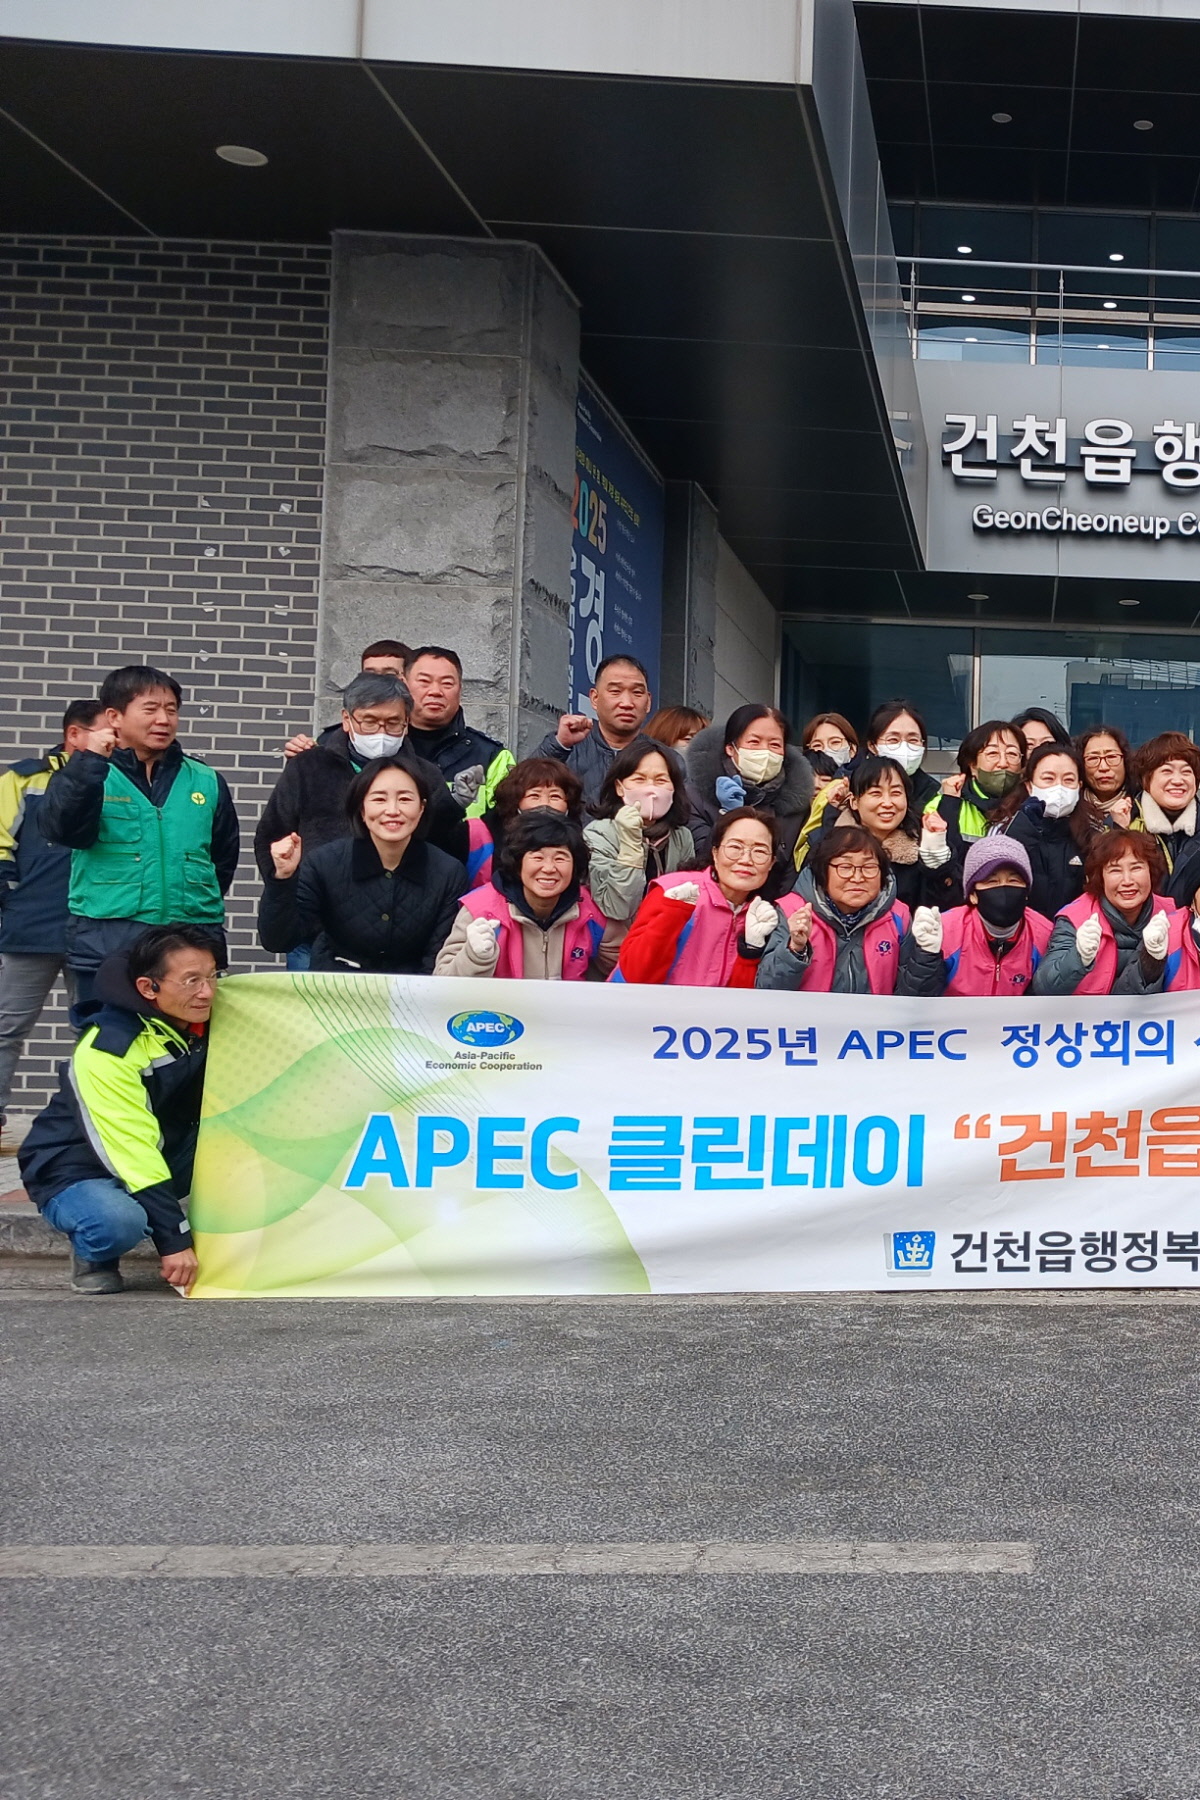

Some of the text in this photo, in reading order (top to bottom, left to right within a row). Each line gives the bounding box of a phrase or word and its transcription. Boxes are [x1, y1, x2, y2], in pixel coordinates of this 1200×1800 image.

[973, 504, 1170, 540] GeonCheoneup
[466, 1022, 505, 1033] APEC
[454, 1050, 516, 1061] Asia-Pacific
[652, 1025, 818, 1067] 2025년
[838, 1028, 967, 1061] APEC
[1001, 1020, 1175, 1068] 정상회의
[425, 1061, 543, 1072] Economic Cooperation
[345, 1114, 580, 1191] APEC
[607, 1114, 925, 1191] 클린데이
